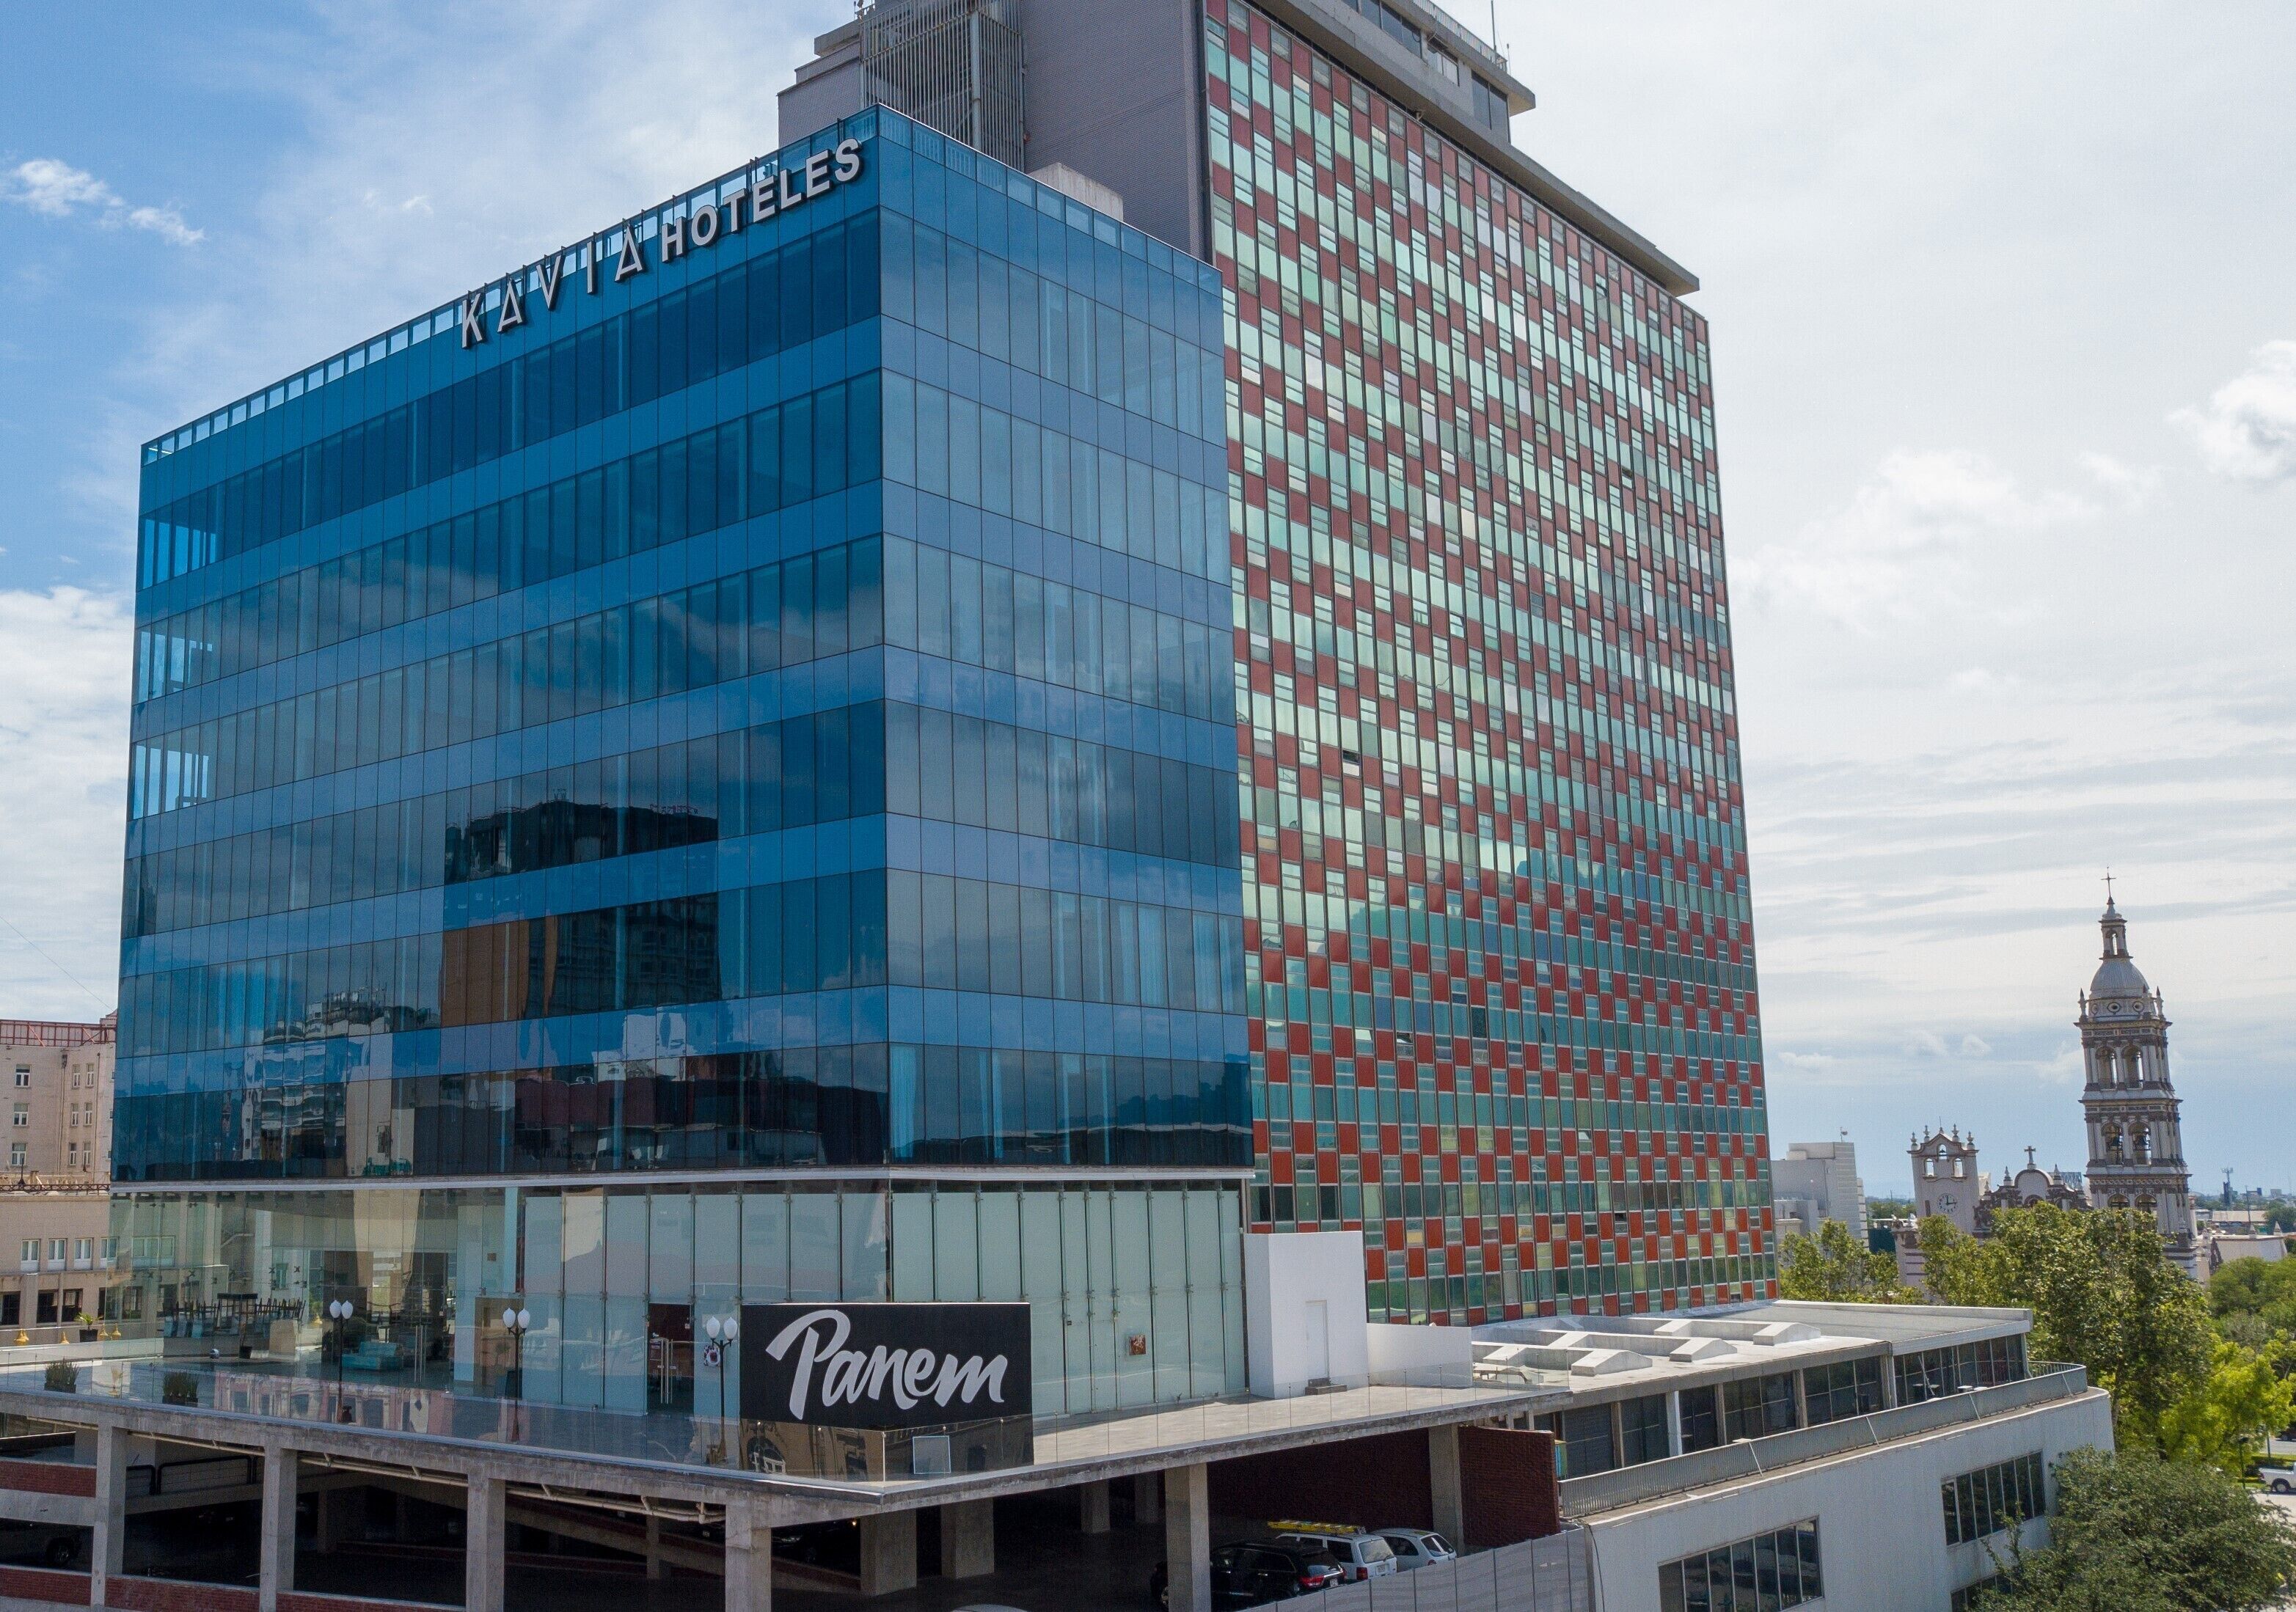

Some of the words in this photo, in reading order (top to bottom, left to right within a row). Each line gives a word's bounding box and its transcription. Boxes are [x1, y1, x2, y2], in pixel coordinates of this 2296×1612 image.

[461, 223, 646, 350] KAVIA
[661, 137, 865, 264] HOTELES
[765, 1308, 1009, 1421] Panem
